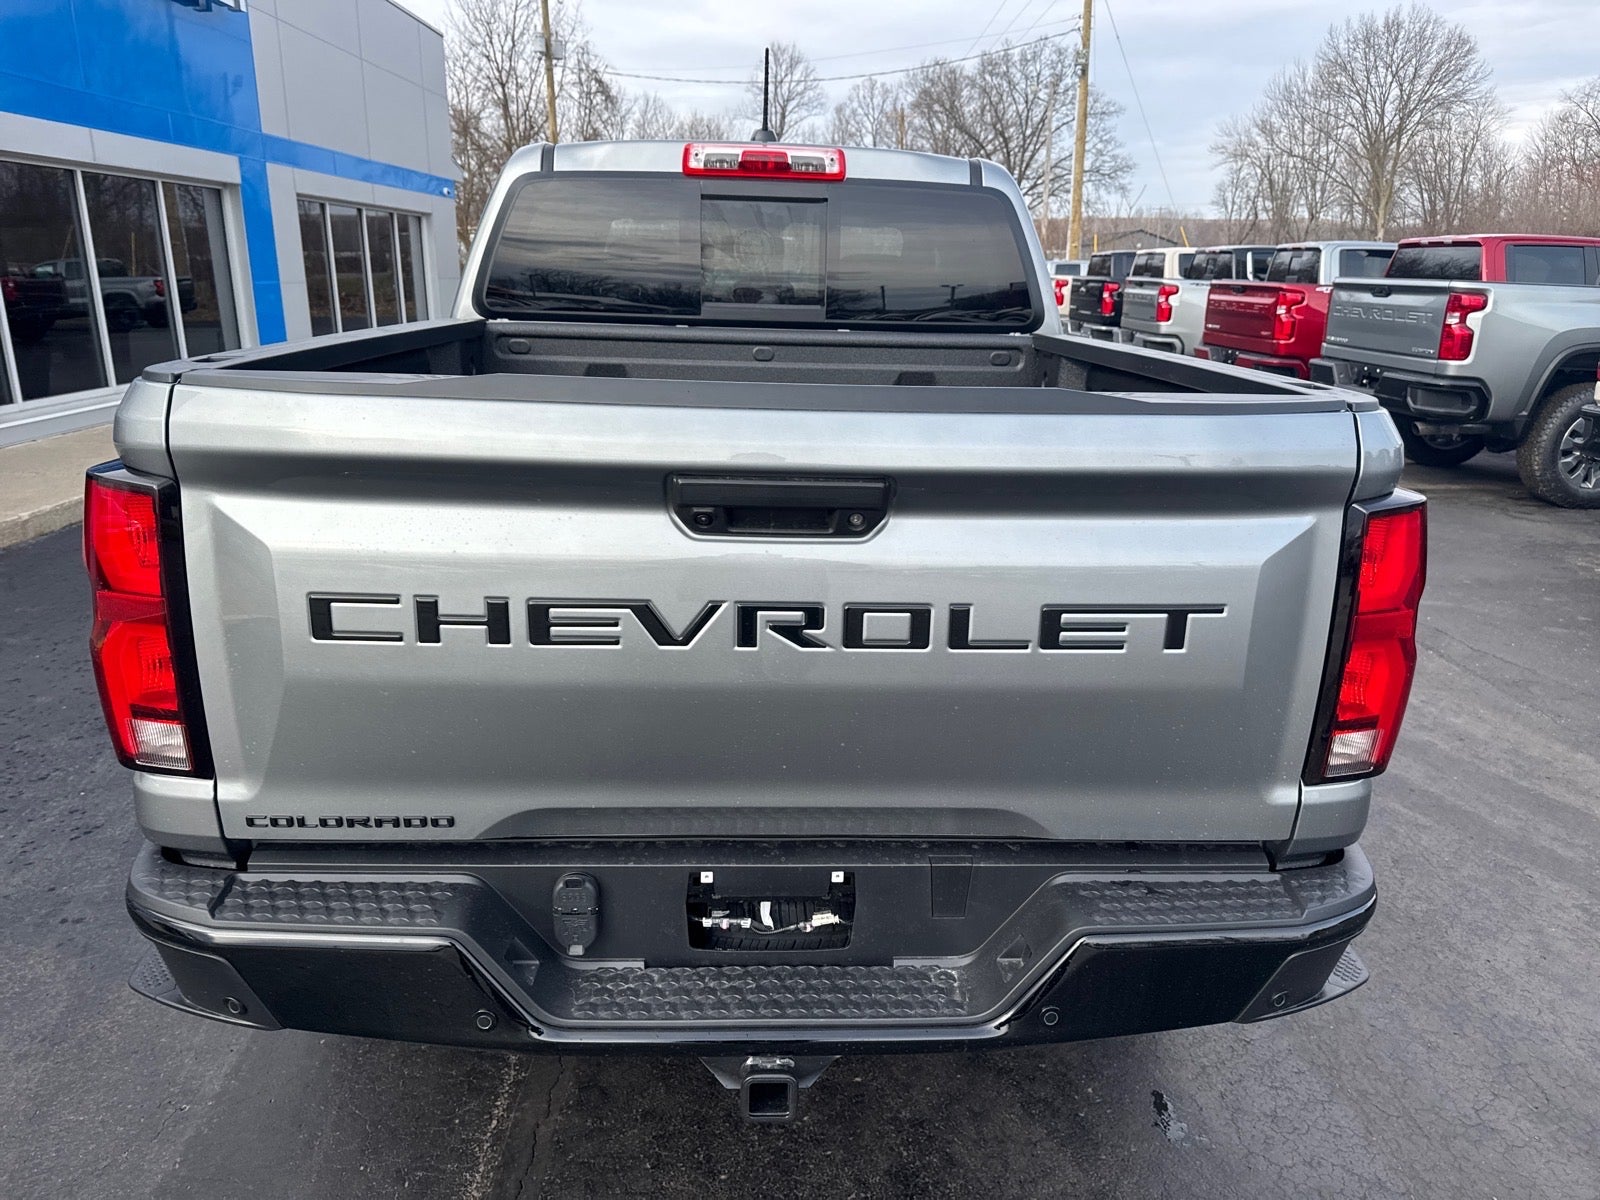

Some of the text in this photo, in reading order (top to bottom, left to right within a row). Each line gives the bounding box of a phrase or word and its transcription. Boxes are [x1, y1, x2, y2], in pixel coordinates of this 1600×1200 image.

[1332, 305, 1433, 325] CHEVROLET
[306, 591, 1228, 653] CHEVROLET
[245, 814, 456, 829] COLORADO
